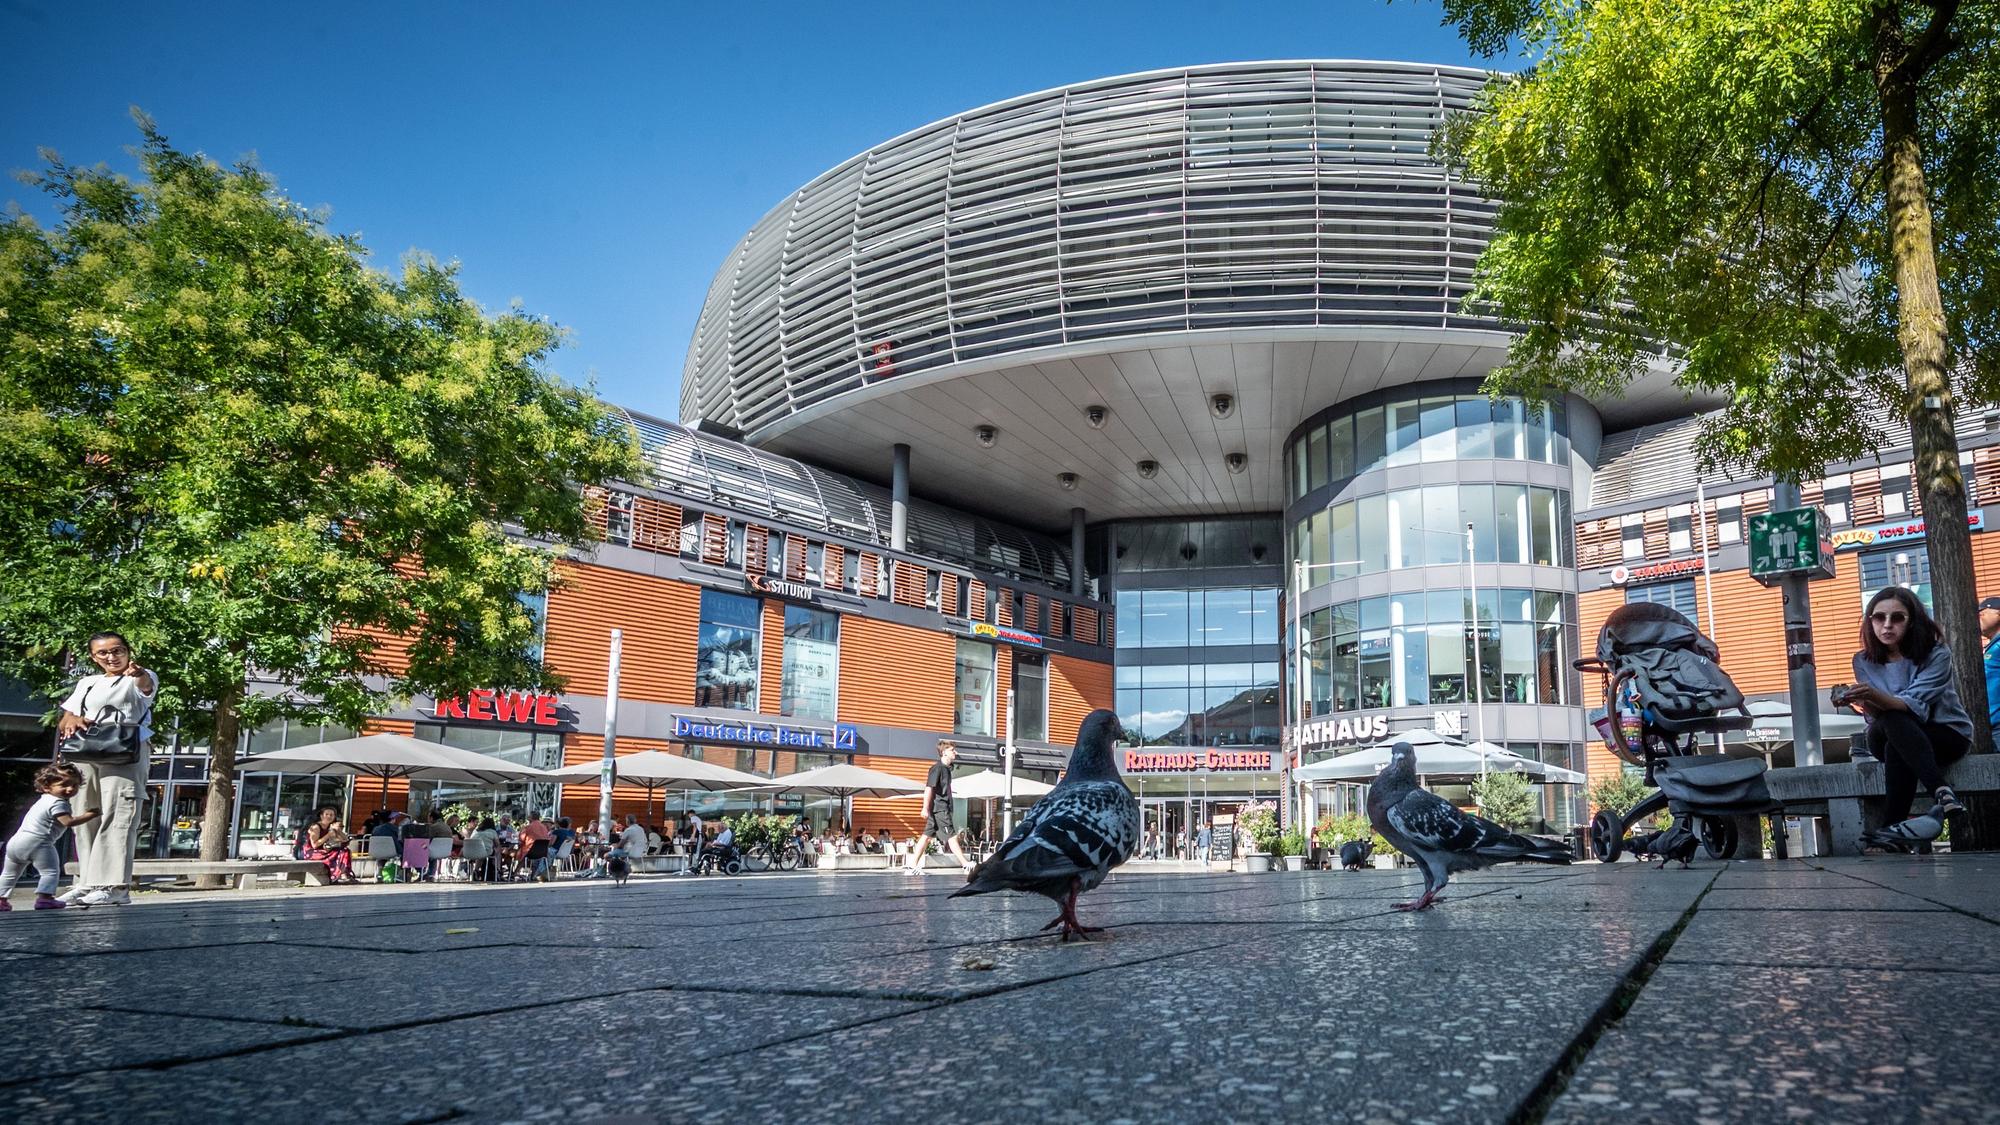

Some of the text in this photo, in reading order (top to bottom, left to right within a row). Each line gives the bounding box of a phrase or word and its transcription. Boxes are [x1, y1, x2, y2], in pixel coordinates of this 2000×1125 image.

[1832, 526, 1905, 544] MYTHS TOYS
[1633, 558, 1704, 577] vodafone
[771, 579, 812, 599] SATURN
[434, 688, 558, 725] REWE
[675, 717, 825, 747] Deutsche Bank
